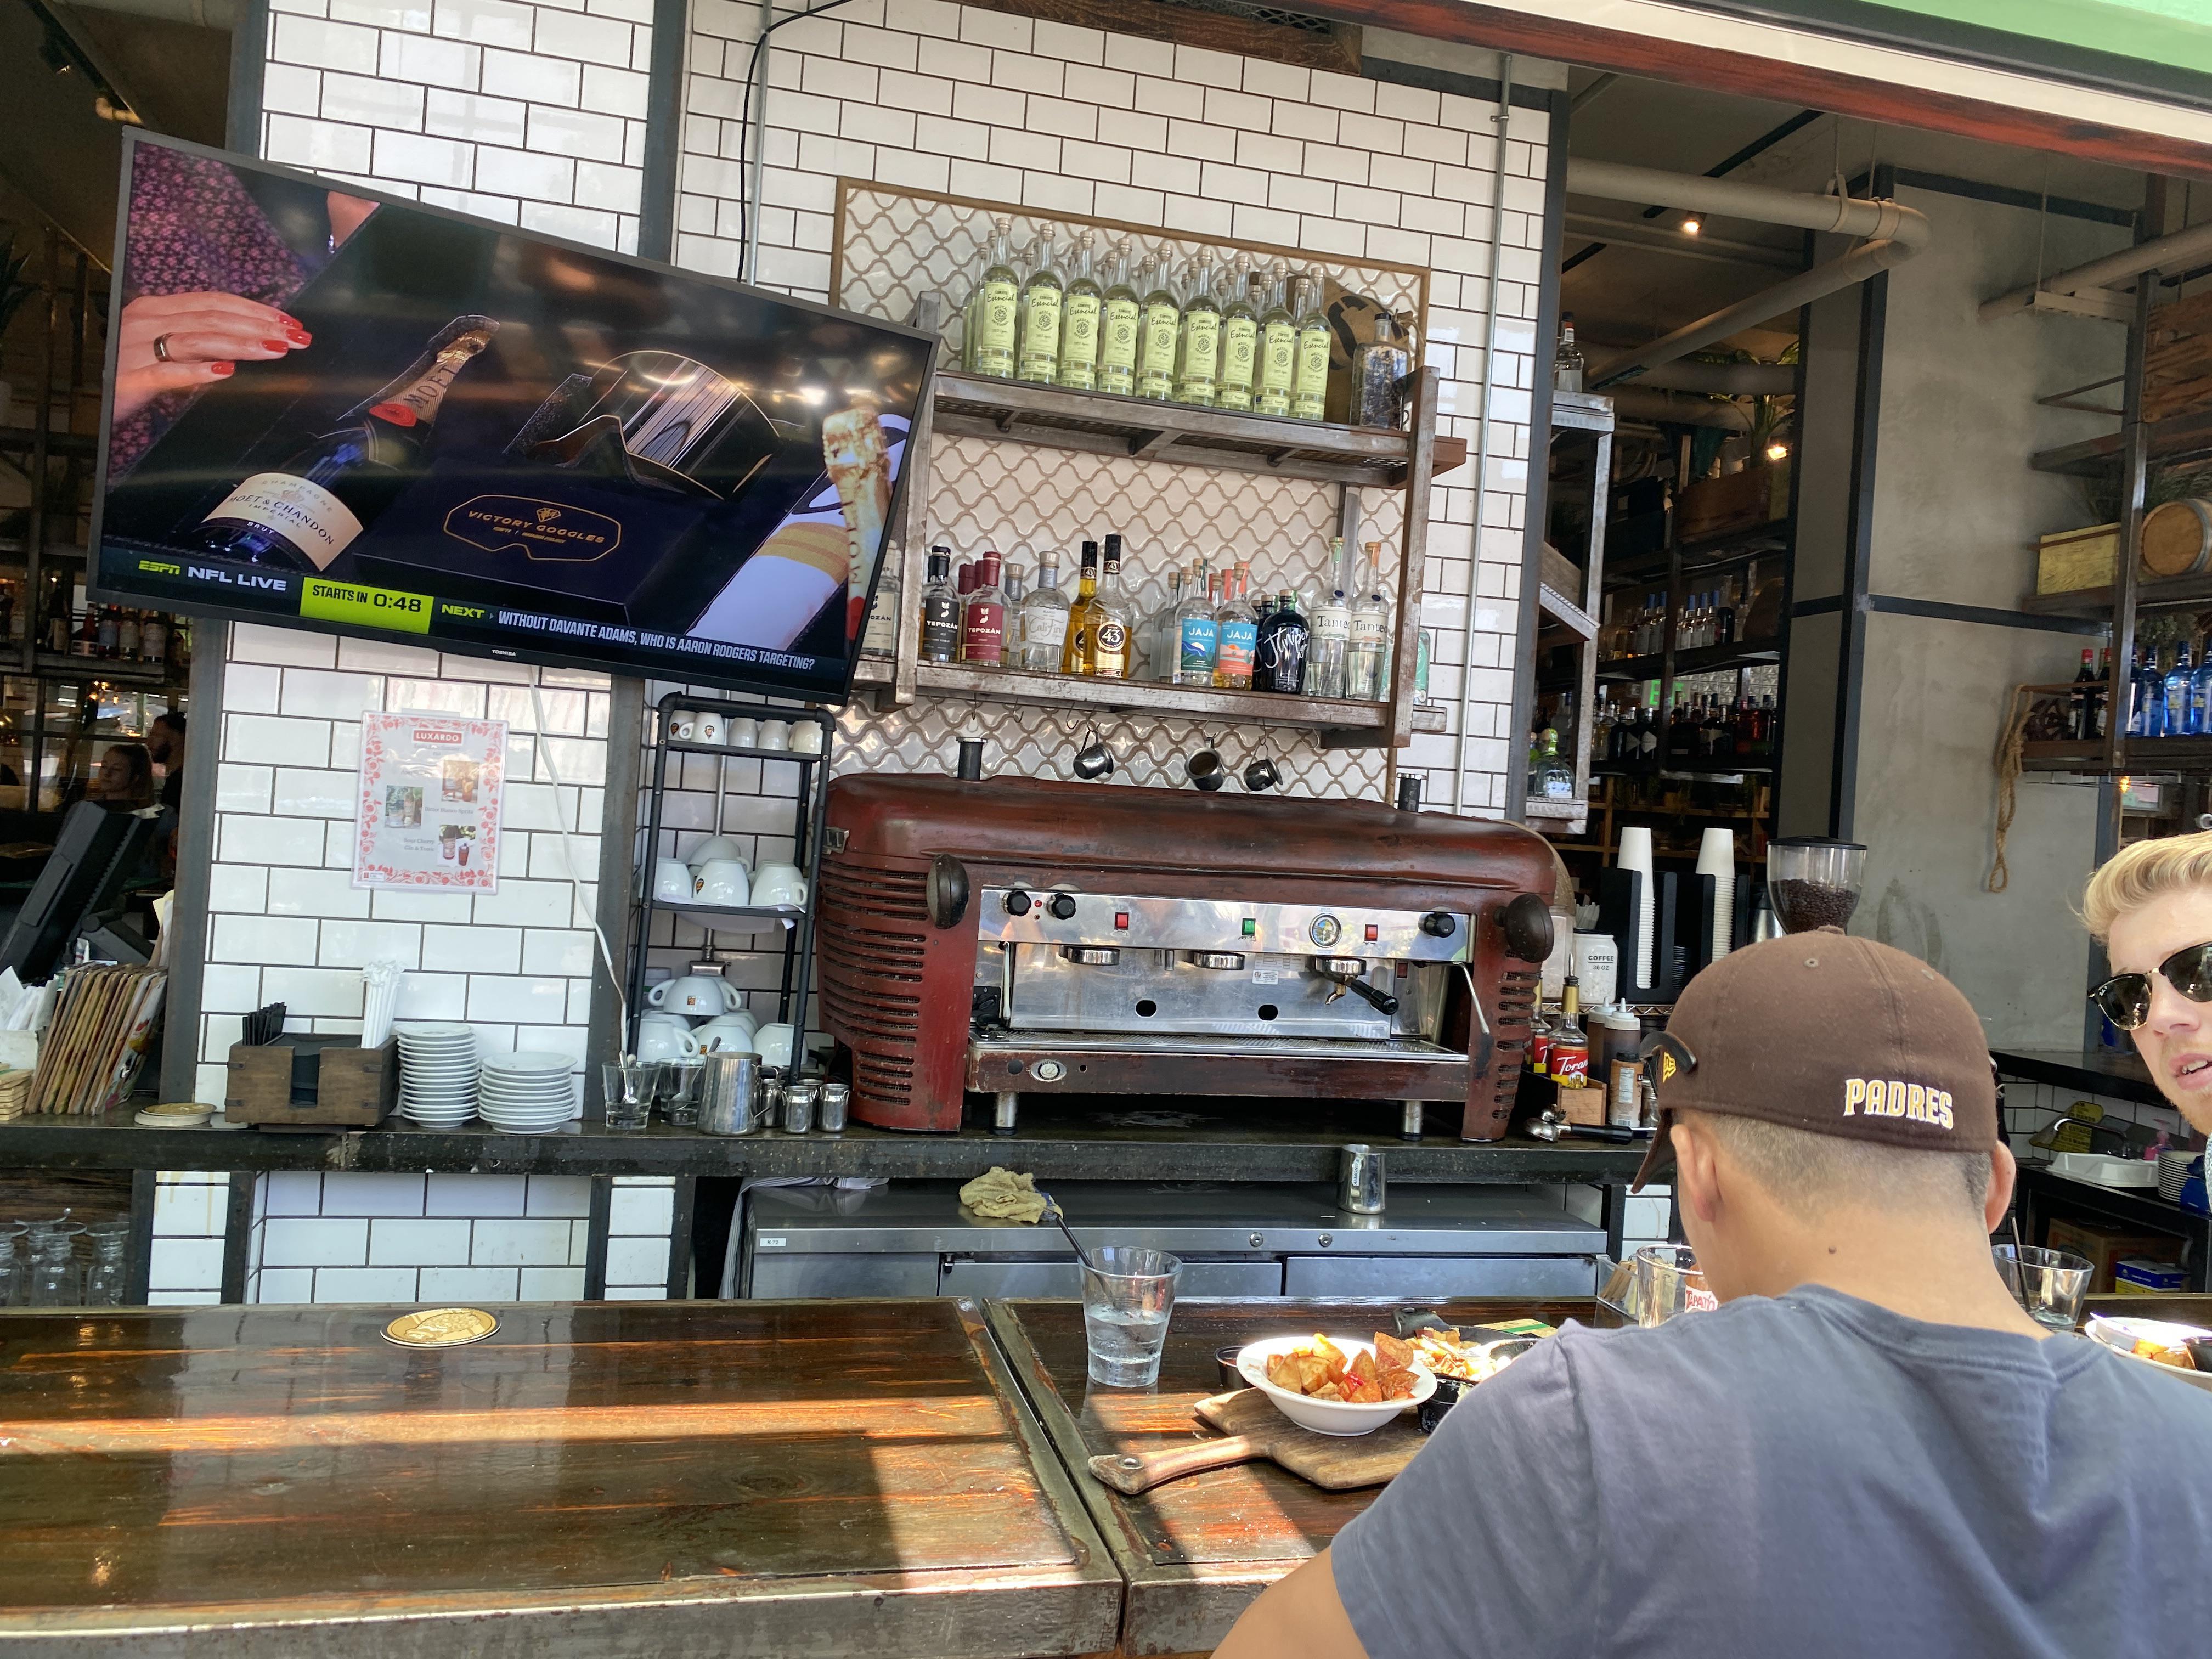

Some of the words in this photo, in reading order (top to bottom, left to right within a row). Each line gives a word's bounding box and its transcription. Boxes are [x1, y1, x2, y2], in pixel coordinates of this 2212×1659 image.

[987, 293, 1014, 302] Esencial
[1031, 298, 1058, 307] Esencial
[1070, 307, 1097, 315] Esencial
[1110, 312, 1136, 320] Esencial
[1151, 317, 1177, 325] Esencial
[1191, 323, 1217, 331] Esencial
[1231, 330, 1255, 338] Esencial
[1269, 335, 1293, 343] Esencial
[1304, 341, 1329, 349] Esencial
[274, 501, 334, 545] CHANDON
[468, 511, 533, 528] VICTORY
[536, 525, 605, 543] GOGGLES
[247, 522, 274, 535] BRUT
[138, 560, 180, 575] ESPN
[188, 566, 232, 583] NFL
[237, 574, 286, 591] LIVE
[312, 585, 354, 601] STARTS
[357, 591, 368, 603] IN
[374, 594, 421, 612] 0:48
[927, 620, 958, 630] TEPOZÁN
[441, 604, 485, 619] NEXT
[499, 611, 549, 630] WITHOUT
[549, 618, 597, 637] DAVANTE
[597, 627, 637, 645] ADAMS,
[640, 633, 664, 648] WHO
[665, 636, 676, 650] IS
[676, 639, 713, 654] AARON
[713, 644, 757, 662] RODGERS
[759, 651, 815, 670] TARGETING?
[1102, 629, 1120, 643] 43
[1189, 627, 1214, 637] JAJA
[1227, 630, 1252, 641] JAJA
[416, 732, 459, 741] LUXARDO
[1557, 1056, 1589, 1076] Toran
[1843, 1078, 1954, 1130] PADRES
